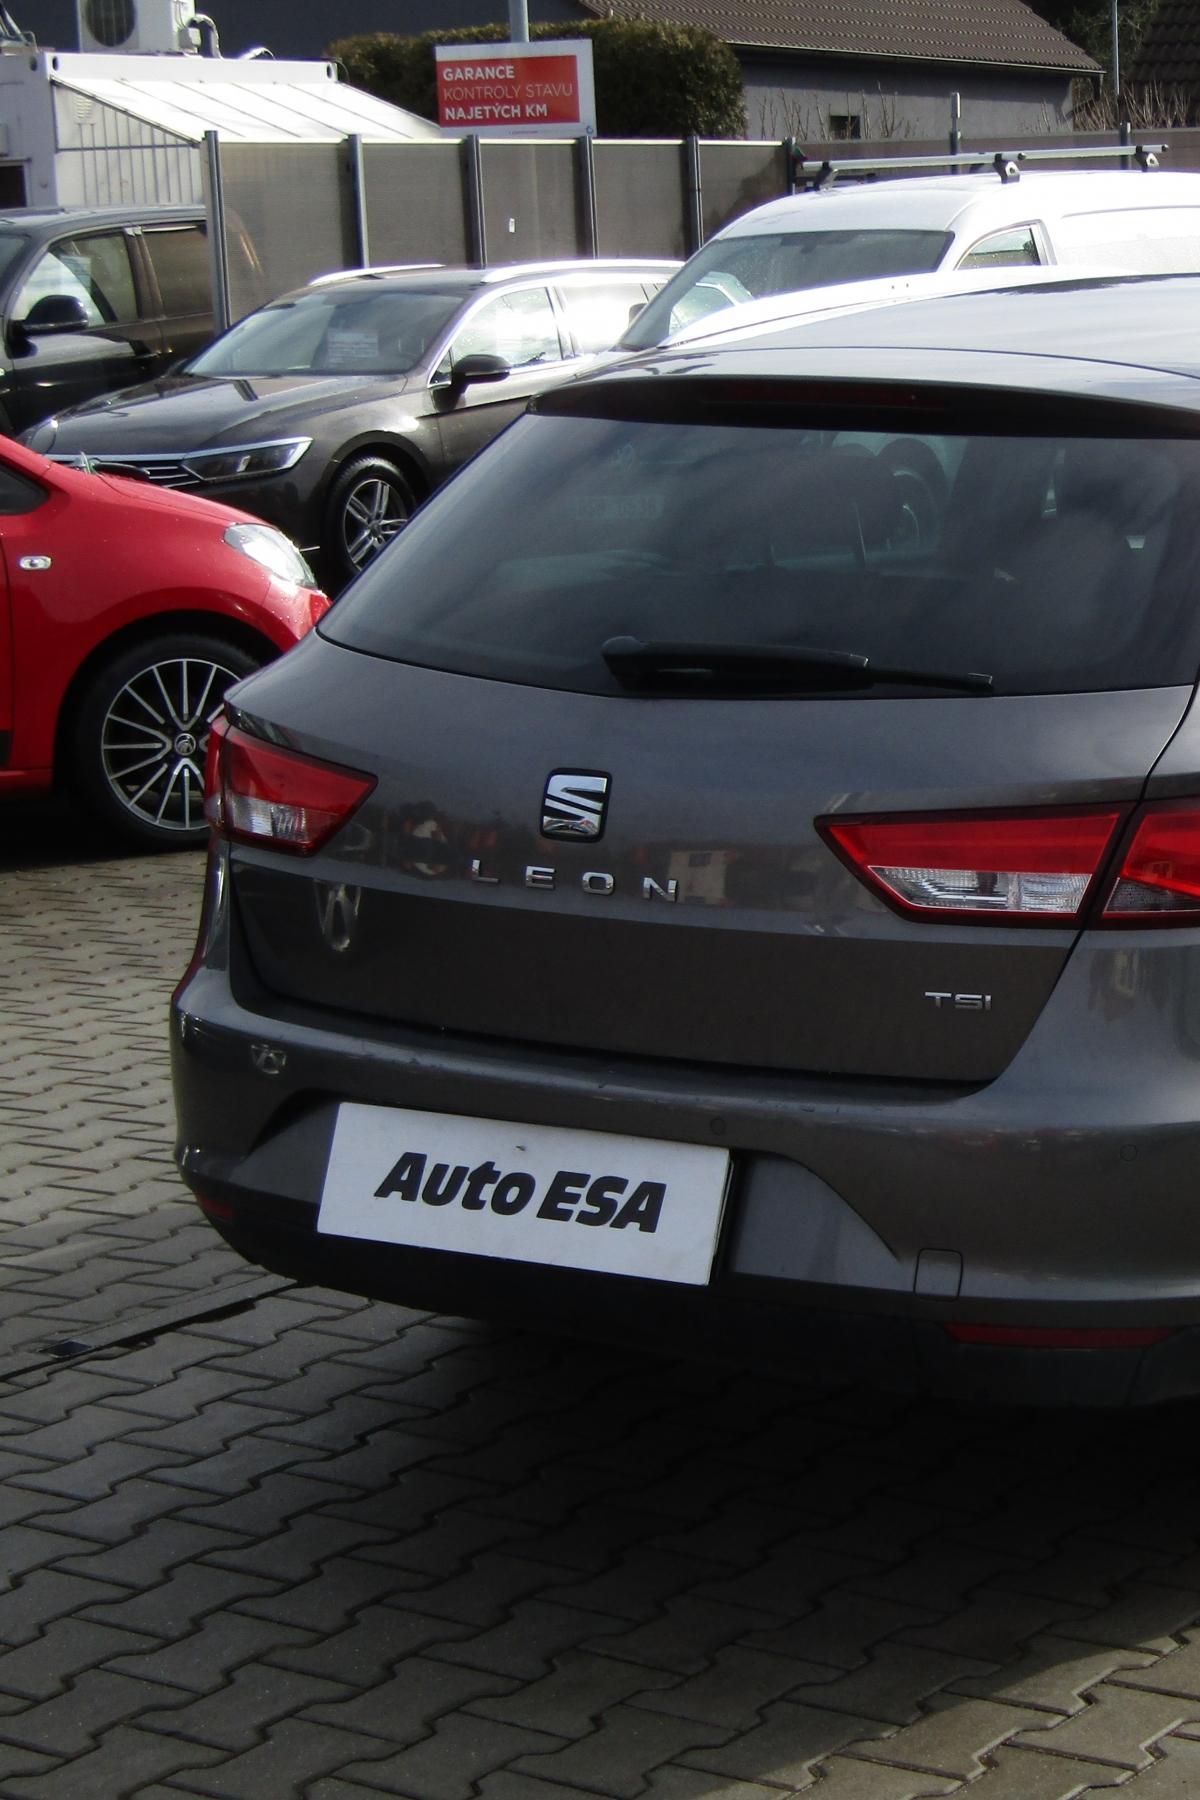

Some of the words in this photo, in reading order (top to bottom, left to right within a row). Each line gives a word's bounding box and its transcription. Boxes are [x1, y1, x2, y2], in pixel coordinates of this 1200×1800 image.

[443, 65, 515, 81] GARANCE
[443, 84, 521, 101] KONTROLY
[526, 83, 573, 98] STAVU
[444, 102, 521, 121] NAJETÝCH
[526, 103, 548, 117] KM
[471, 859, 678, 903] LEON
[924, 991, 992, 1010] TSI
[373, 1151, 536, 1216] Auto
[536, 1170, 667, 1234] ESA
